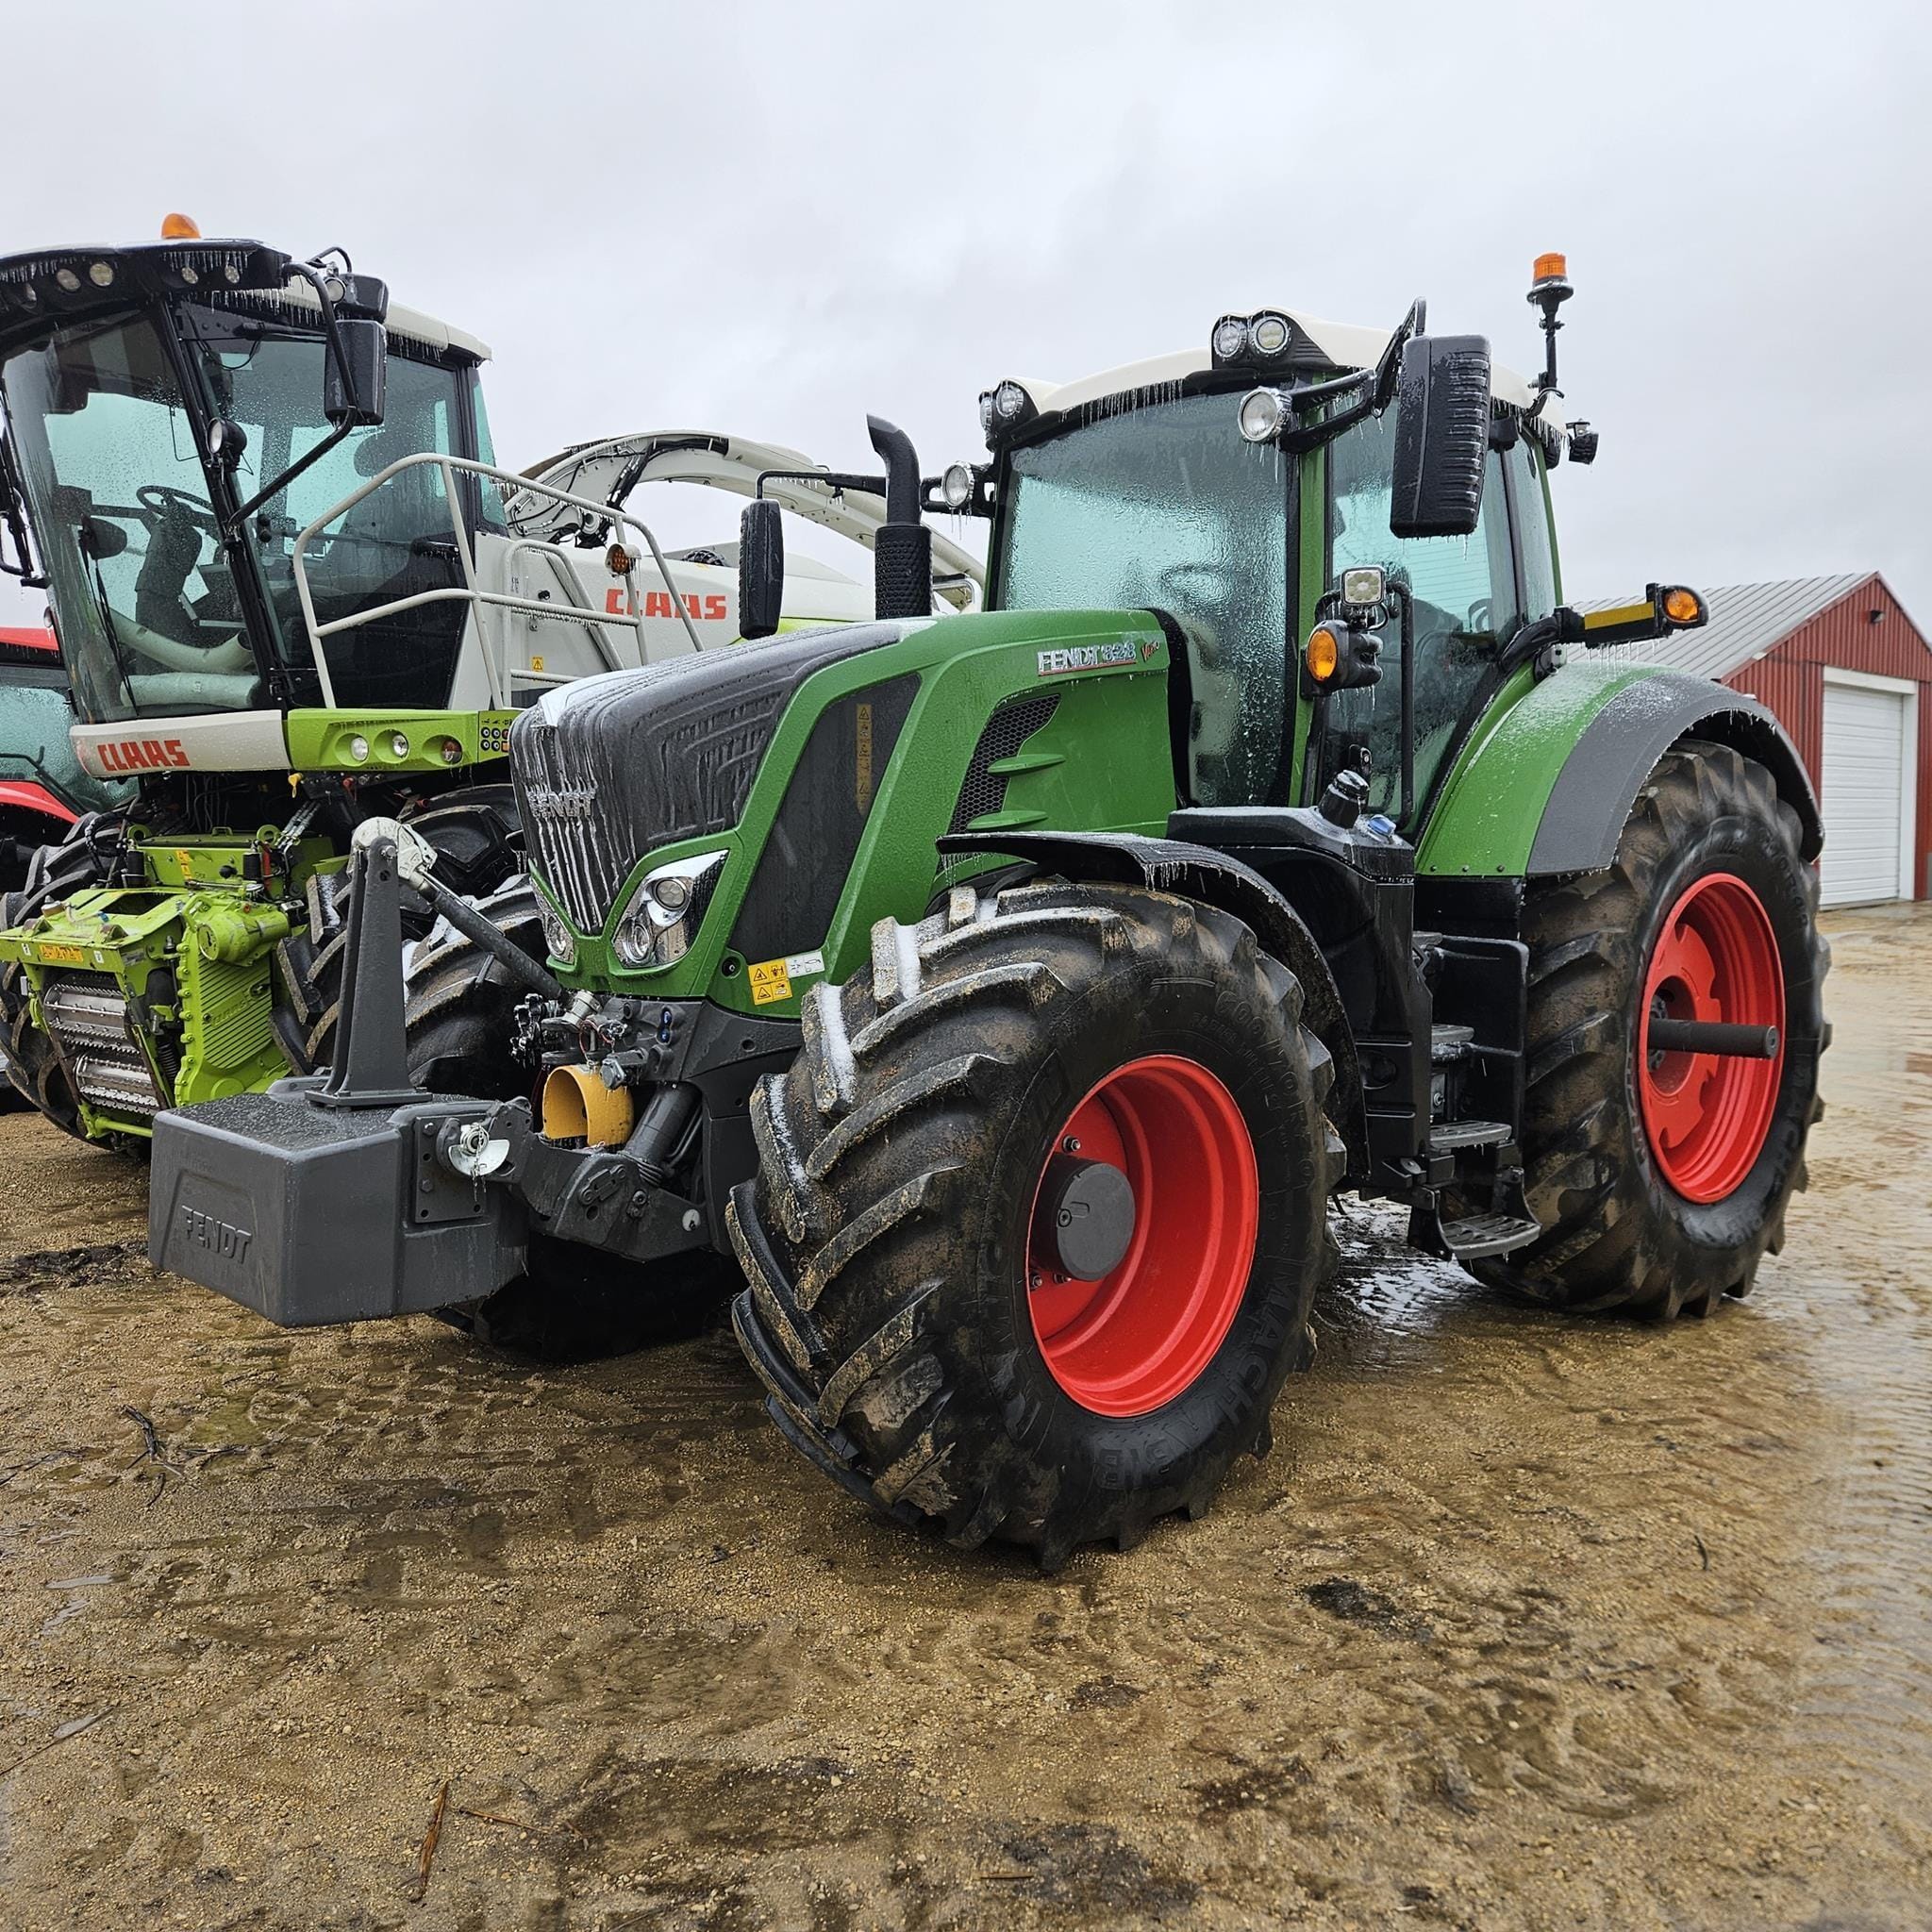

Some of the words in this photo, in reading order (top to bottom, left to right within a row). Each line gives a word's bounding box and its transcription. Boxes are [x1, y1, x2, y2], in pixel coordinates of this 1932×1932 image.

[1038, 645, 1100, 673] FENDT
[97, 740, 191, 772] CLAAS
[181, 1204, 252, 1265] FENDT
